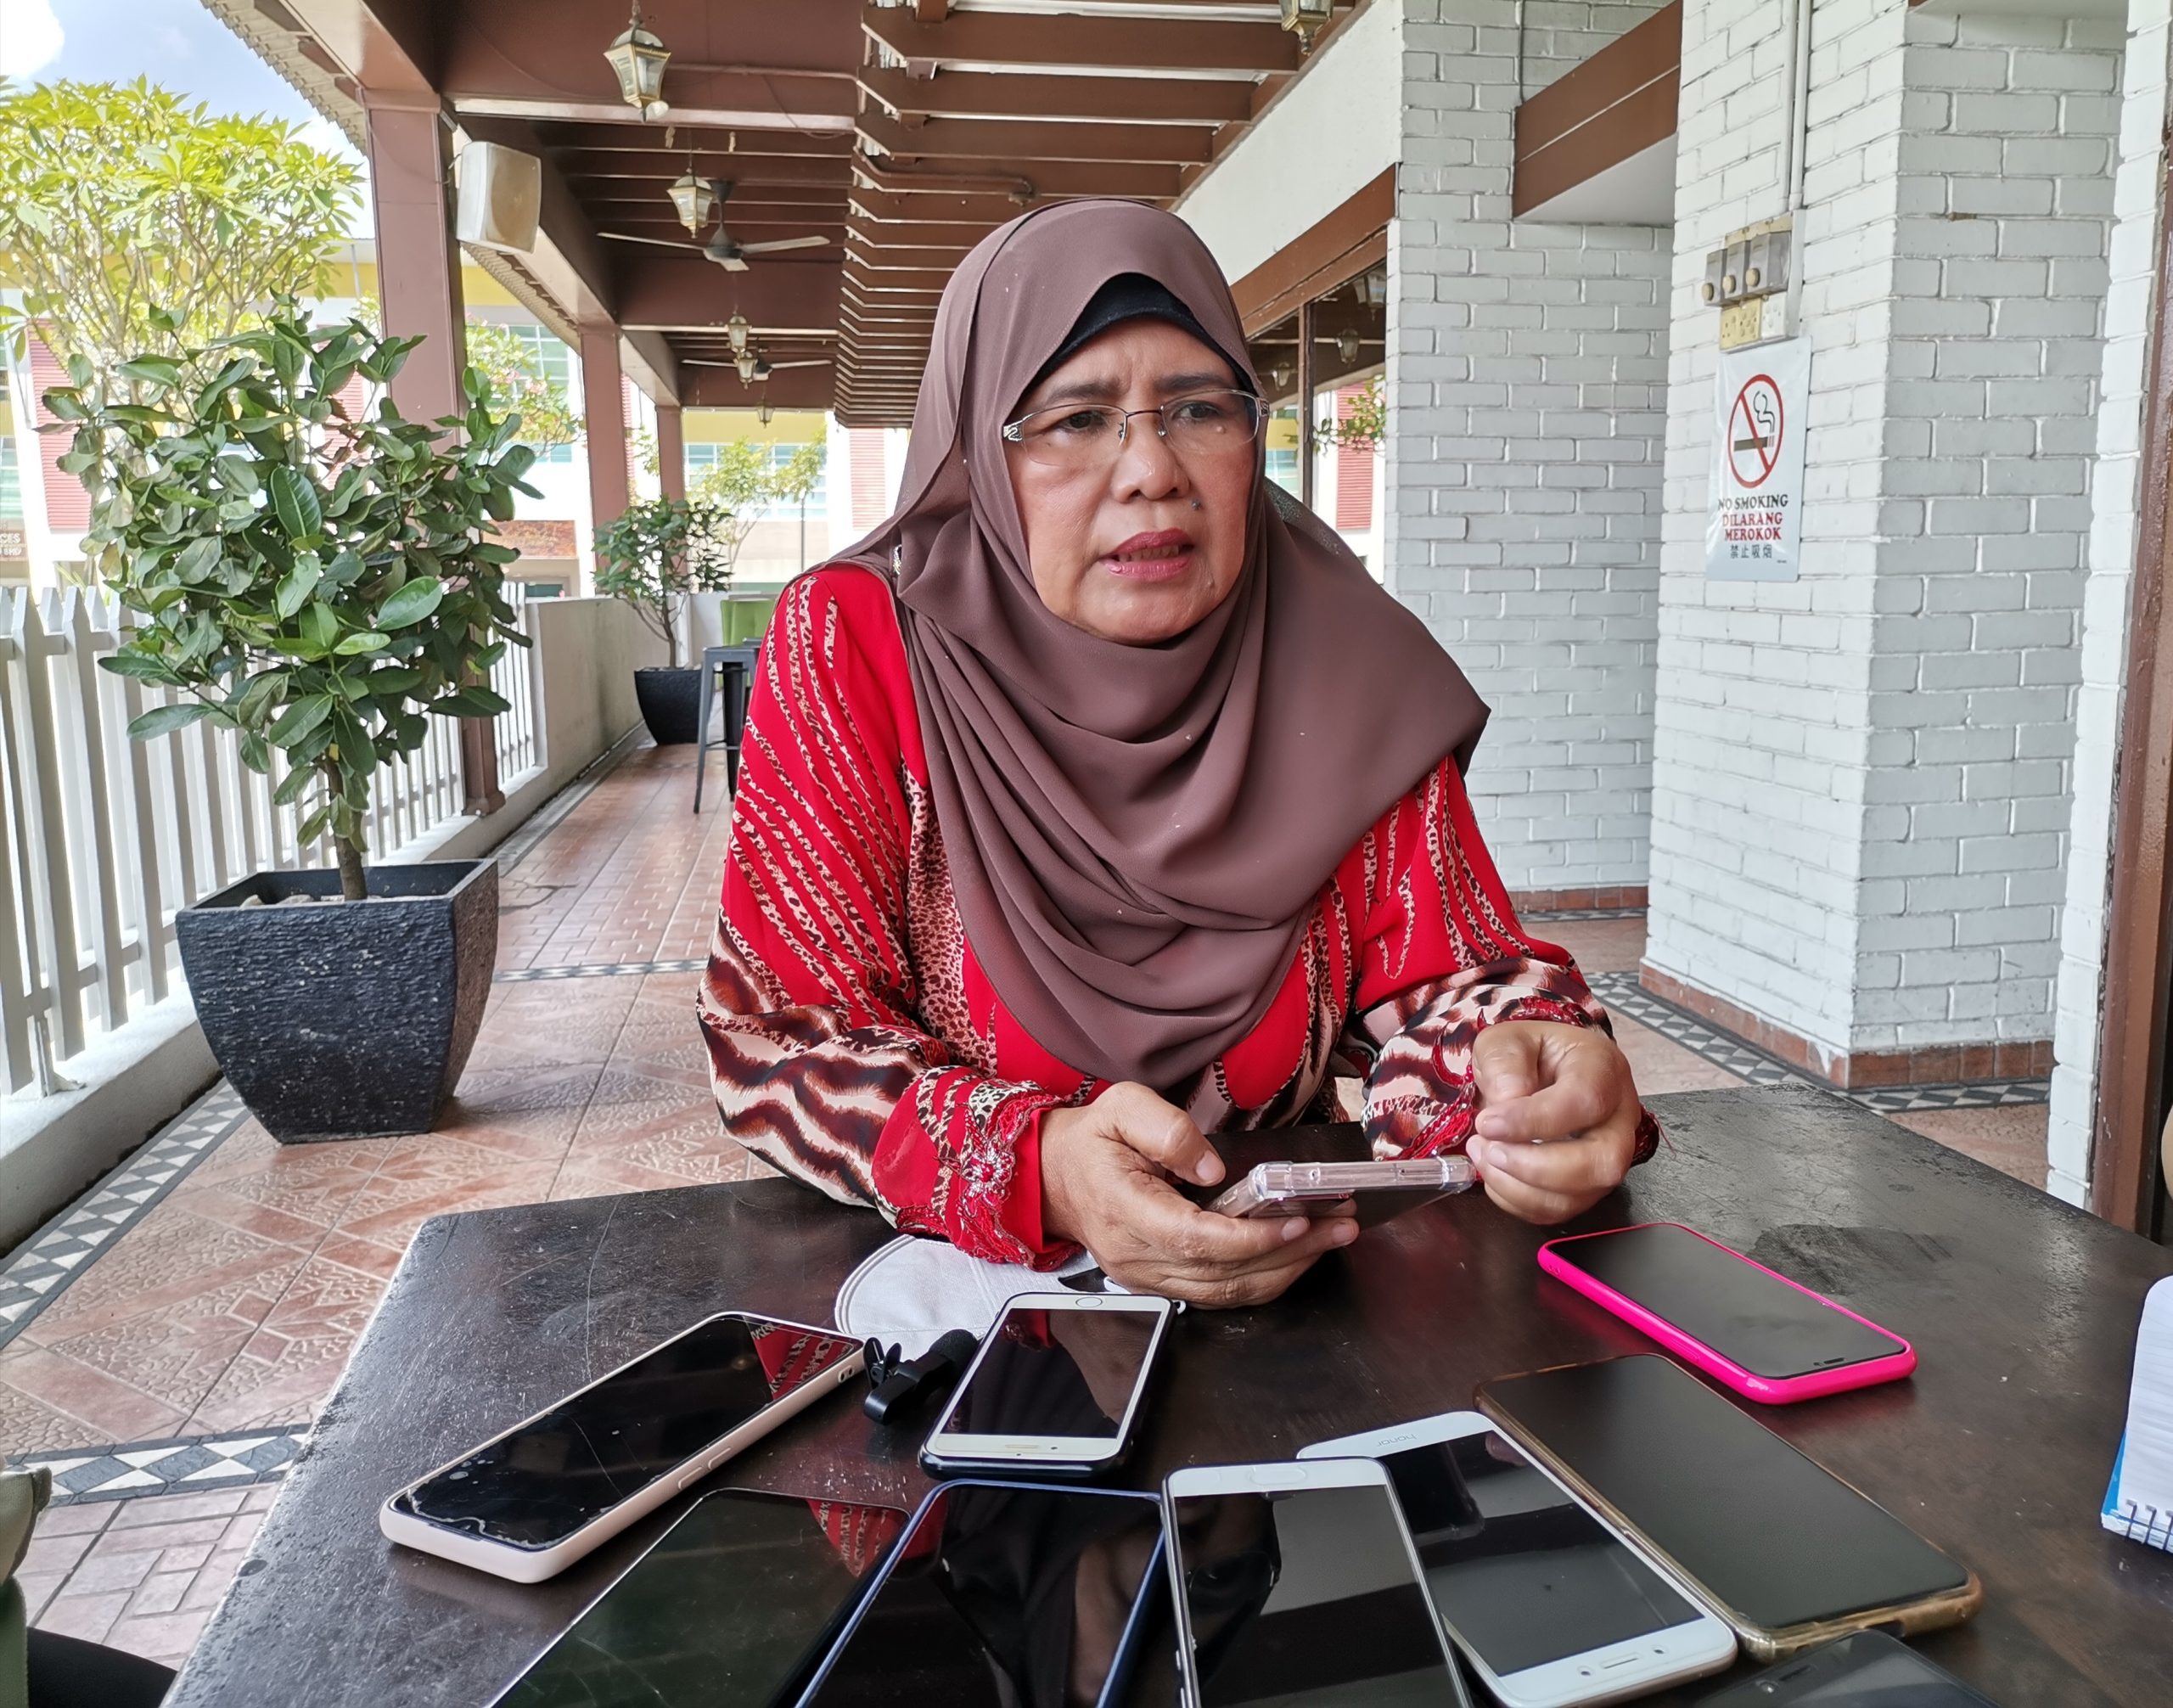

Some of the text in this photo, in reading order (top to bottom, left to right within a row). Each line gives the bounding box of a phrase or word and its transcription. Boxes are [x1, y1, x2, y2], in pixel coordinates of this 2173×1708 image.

[1717, 494, 1788, 510] NO SMOKING
[1722, 512, 1783, 526] DILARANG
[1725, 527, 1782, 541] MEROKOK
[1730, 544, 1772, 559] 禁止吸烟
[1377, 1434, 1418, 1447] honor
